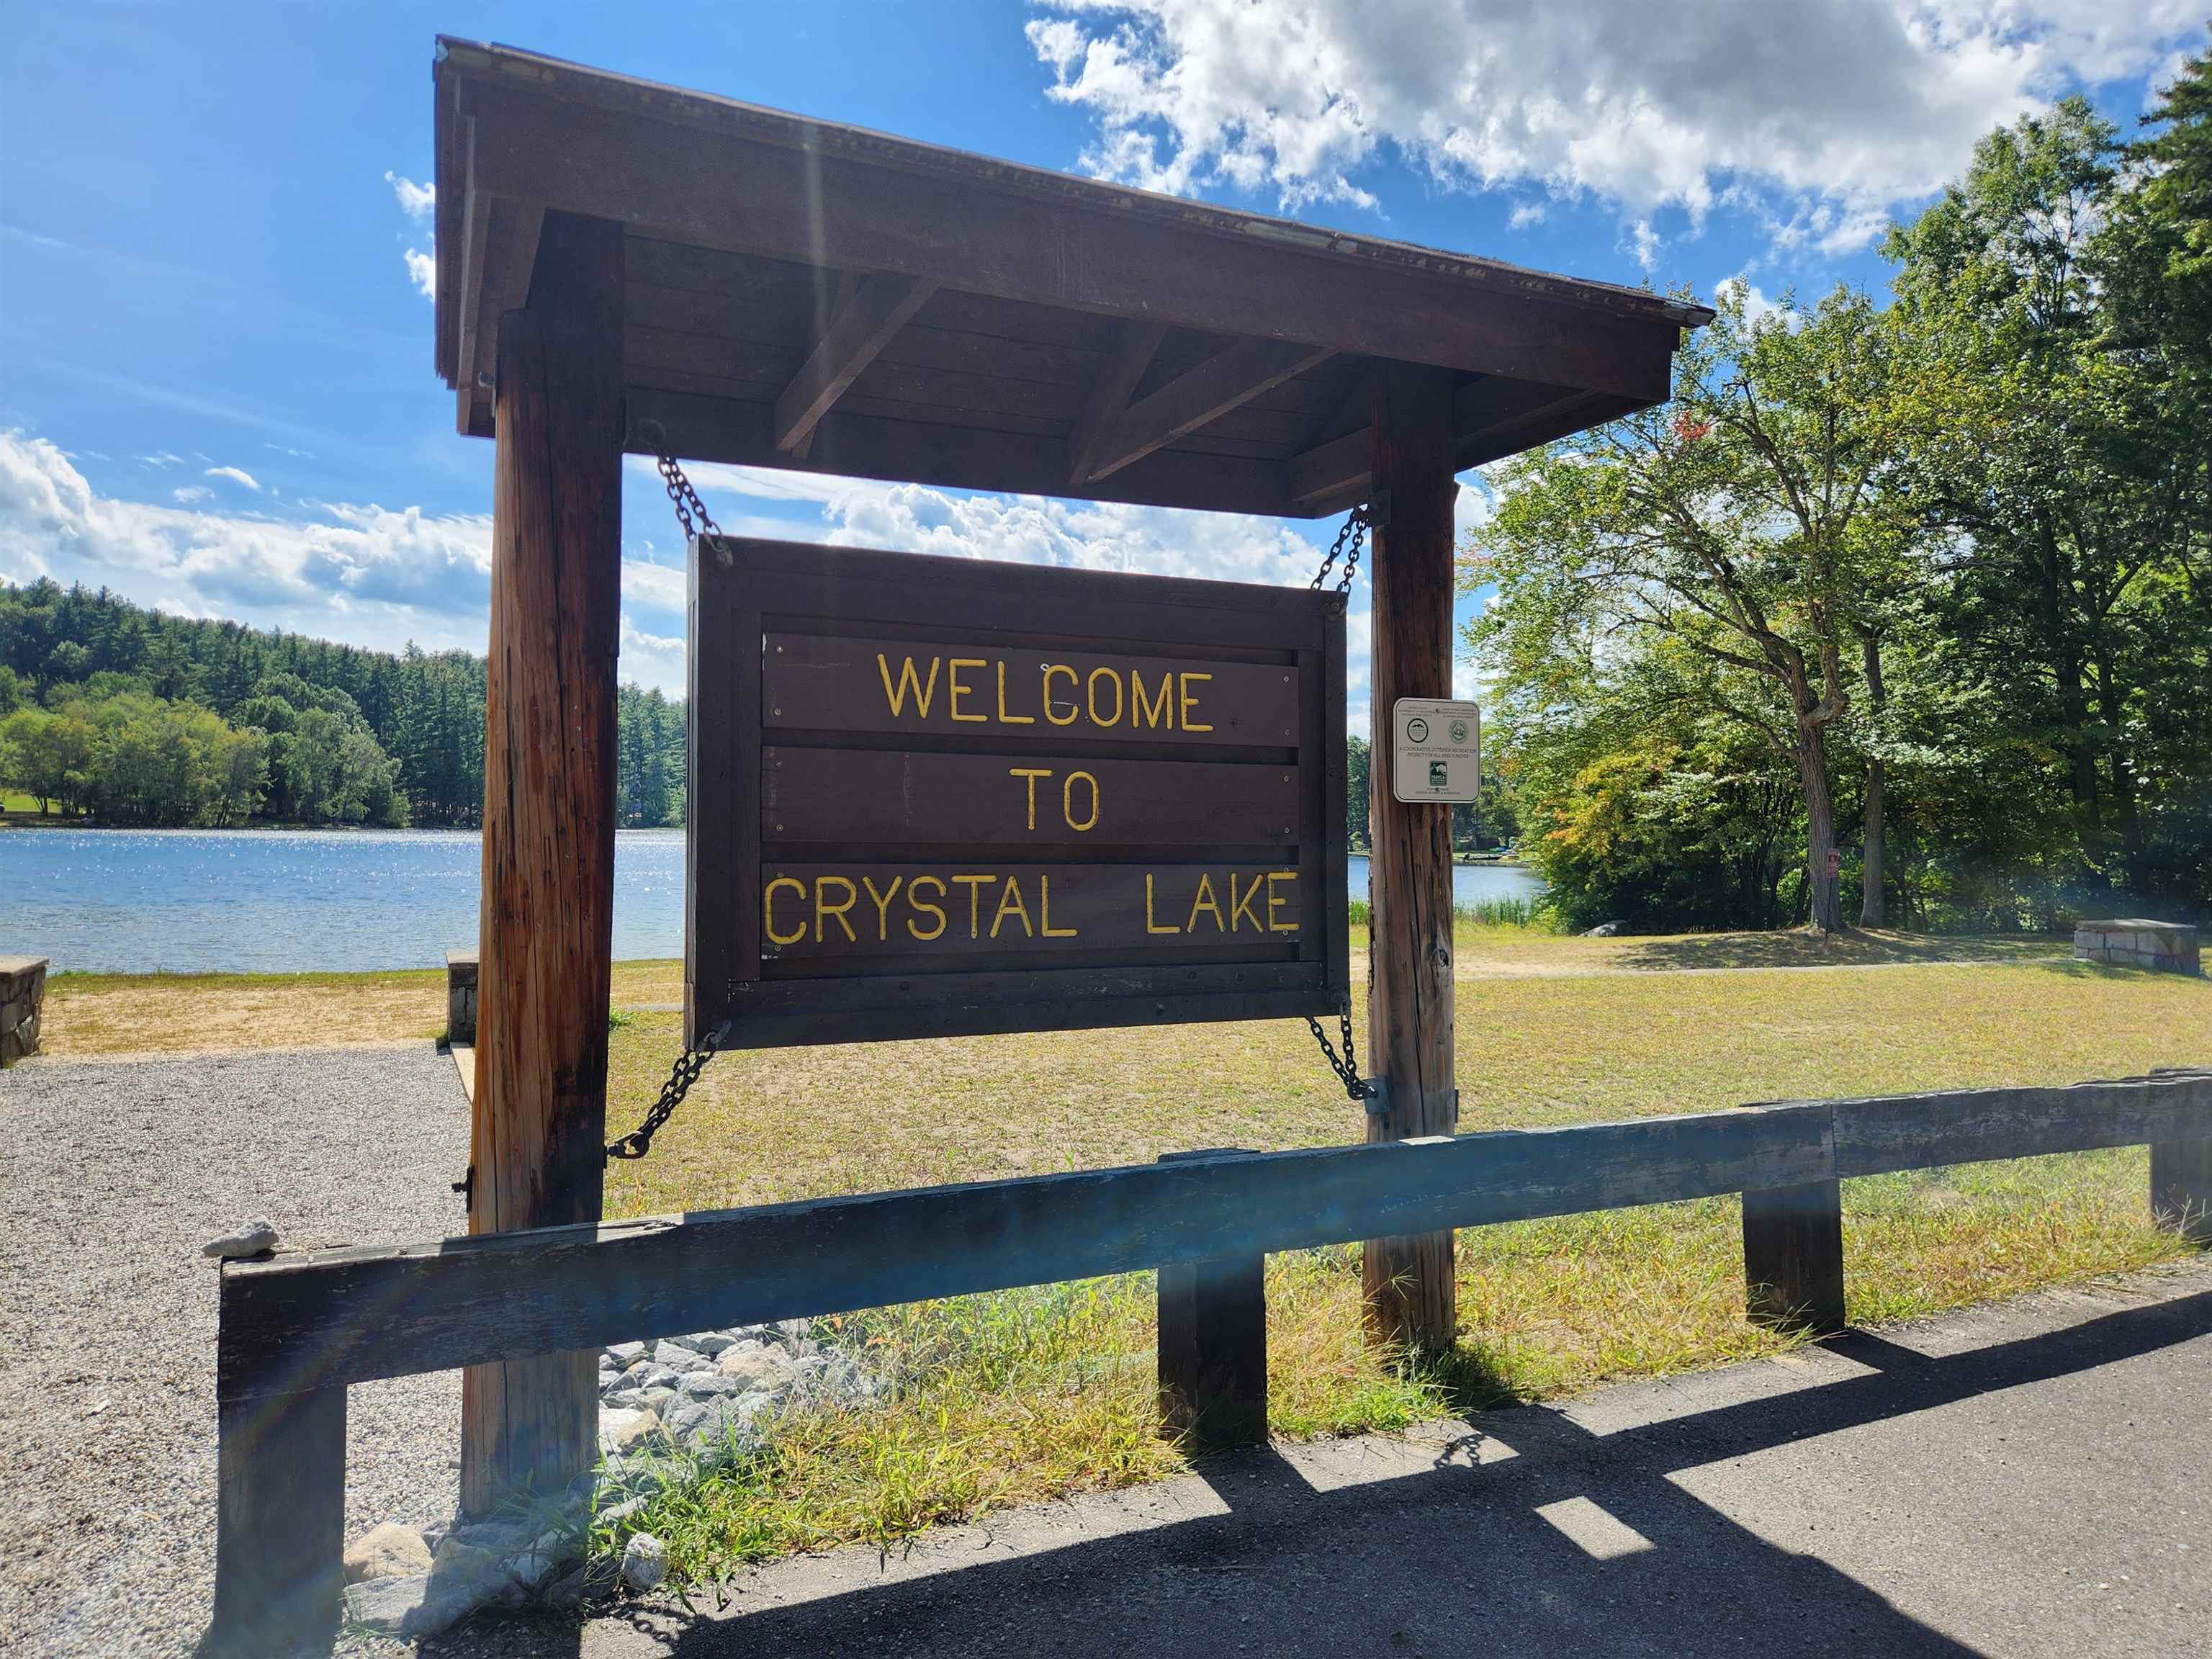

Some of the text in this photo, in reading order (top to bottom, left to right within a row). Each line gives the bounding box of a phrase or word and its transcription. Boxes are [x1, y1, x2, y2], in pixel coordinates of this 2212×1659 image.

[877, 653, 1213, 732] WELCOME
[1010, 768, 1100, 832] TO
[764, 871, 1300, 945] CRYSTAL LAKE
